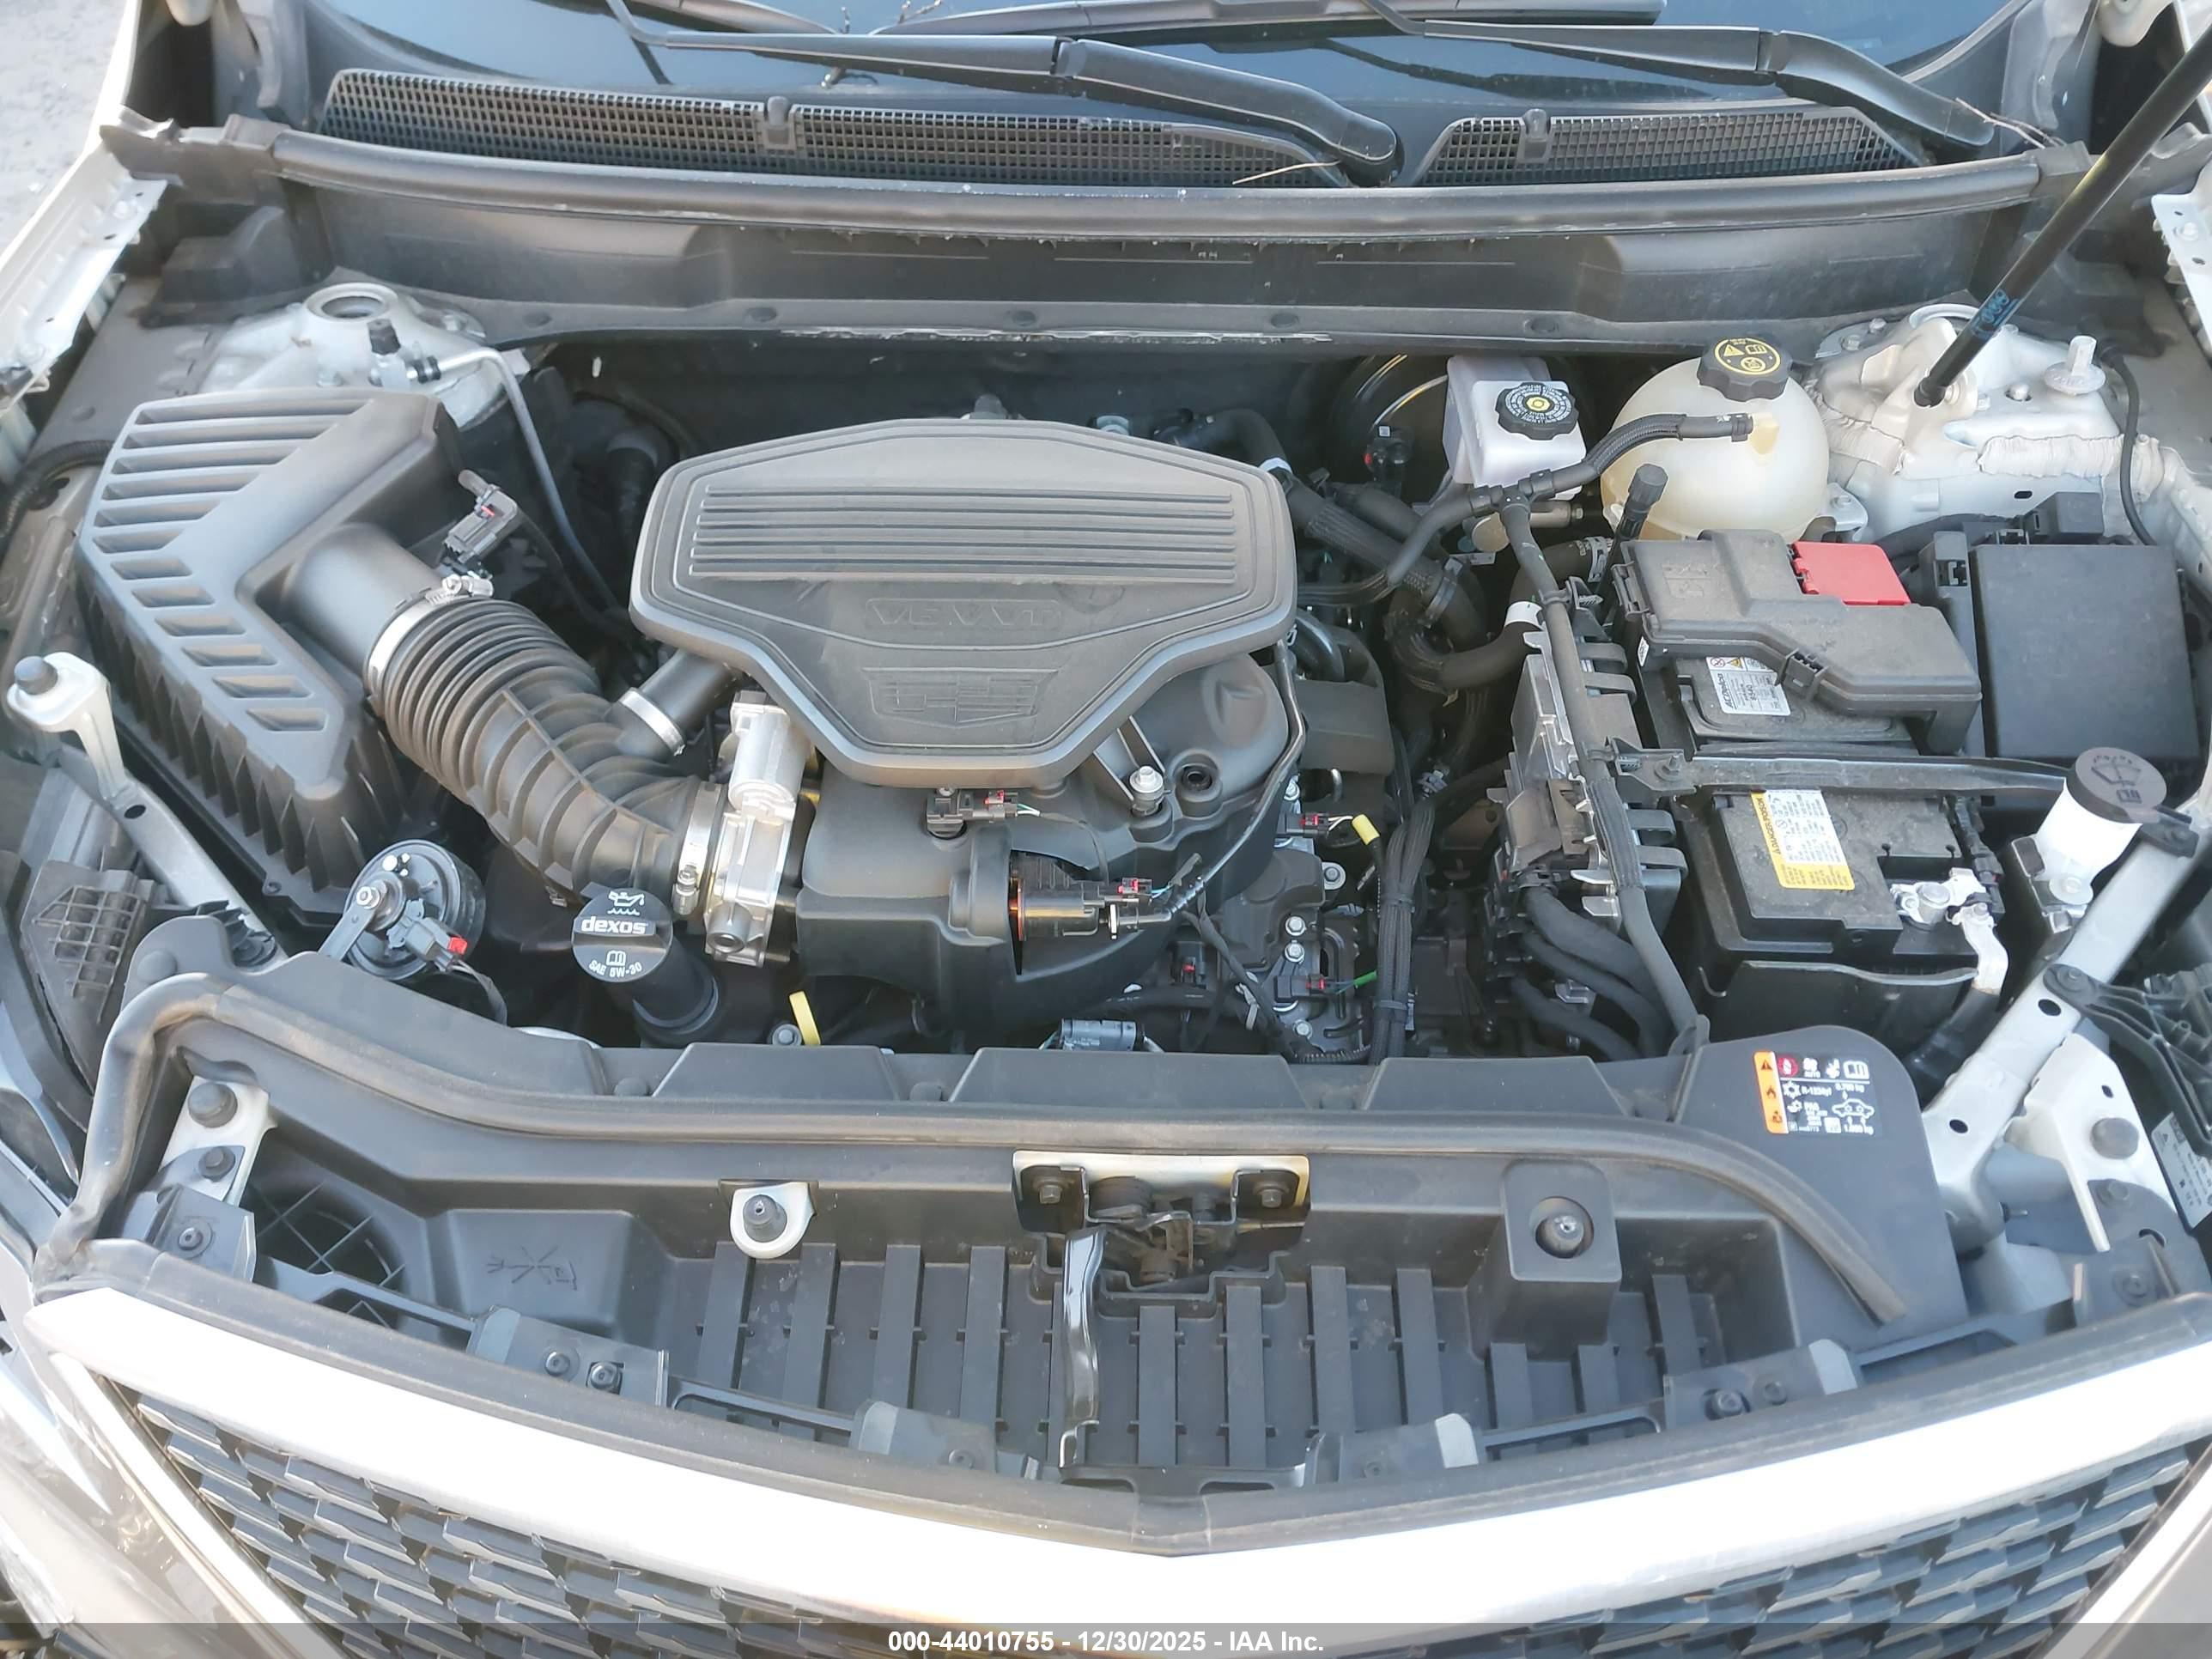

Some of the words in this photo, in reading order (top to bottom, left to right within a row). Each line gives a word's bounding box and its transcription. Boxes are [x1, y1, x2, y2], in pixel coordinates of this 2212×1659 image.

[951, 603, 1062, 628] VVT
[581, 916, 648, 934] dexos
[589, 960, 606, 975] SAE
[609, 962, 642, 977] 5W-30
